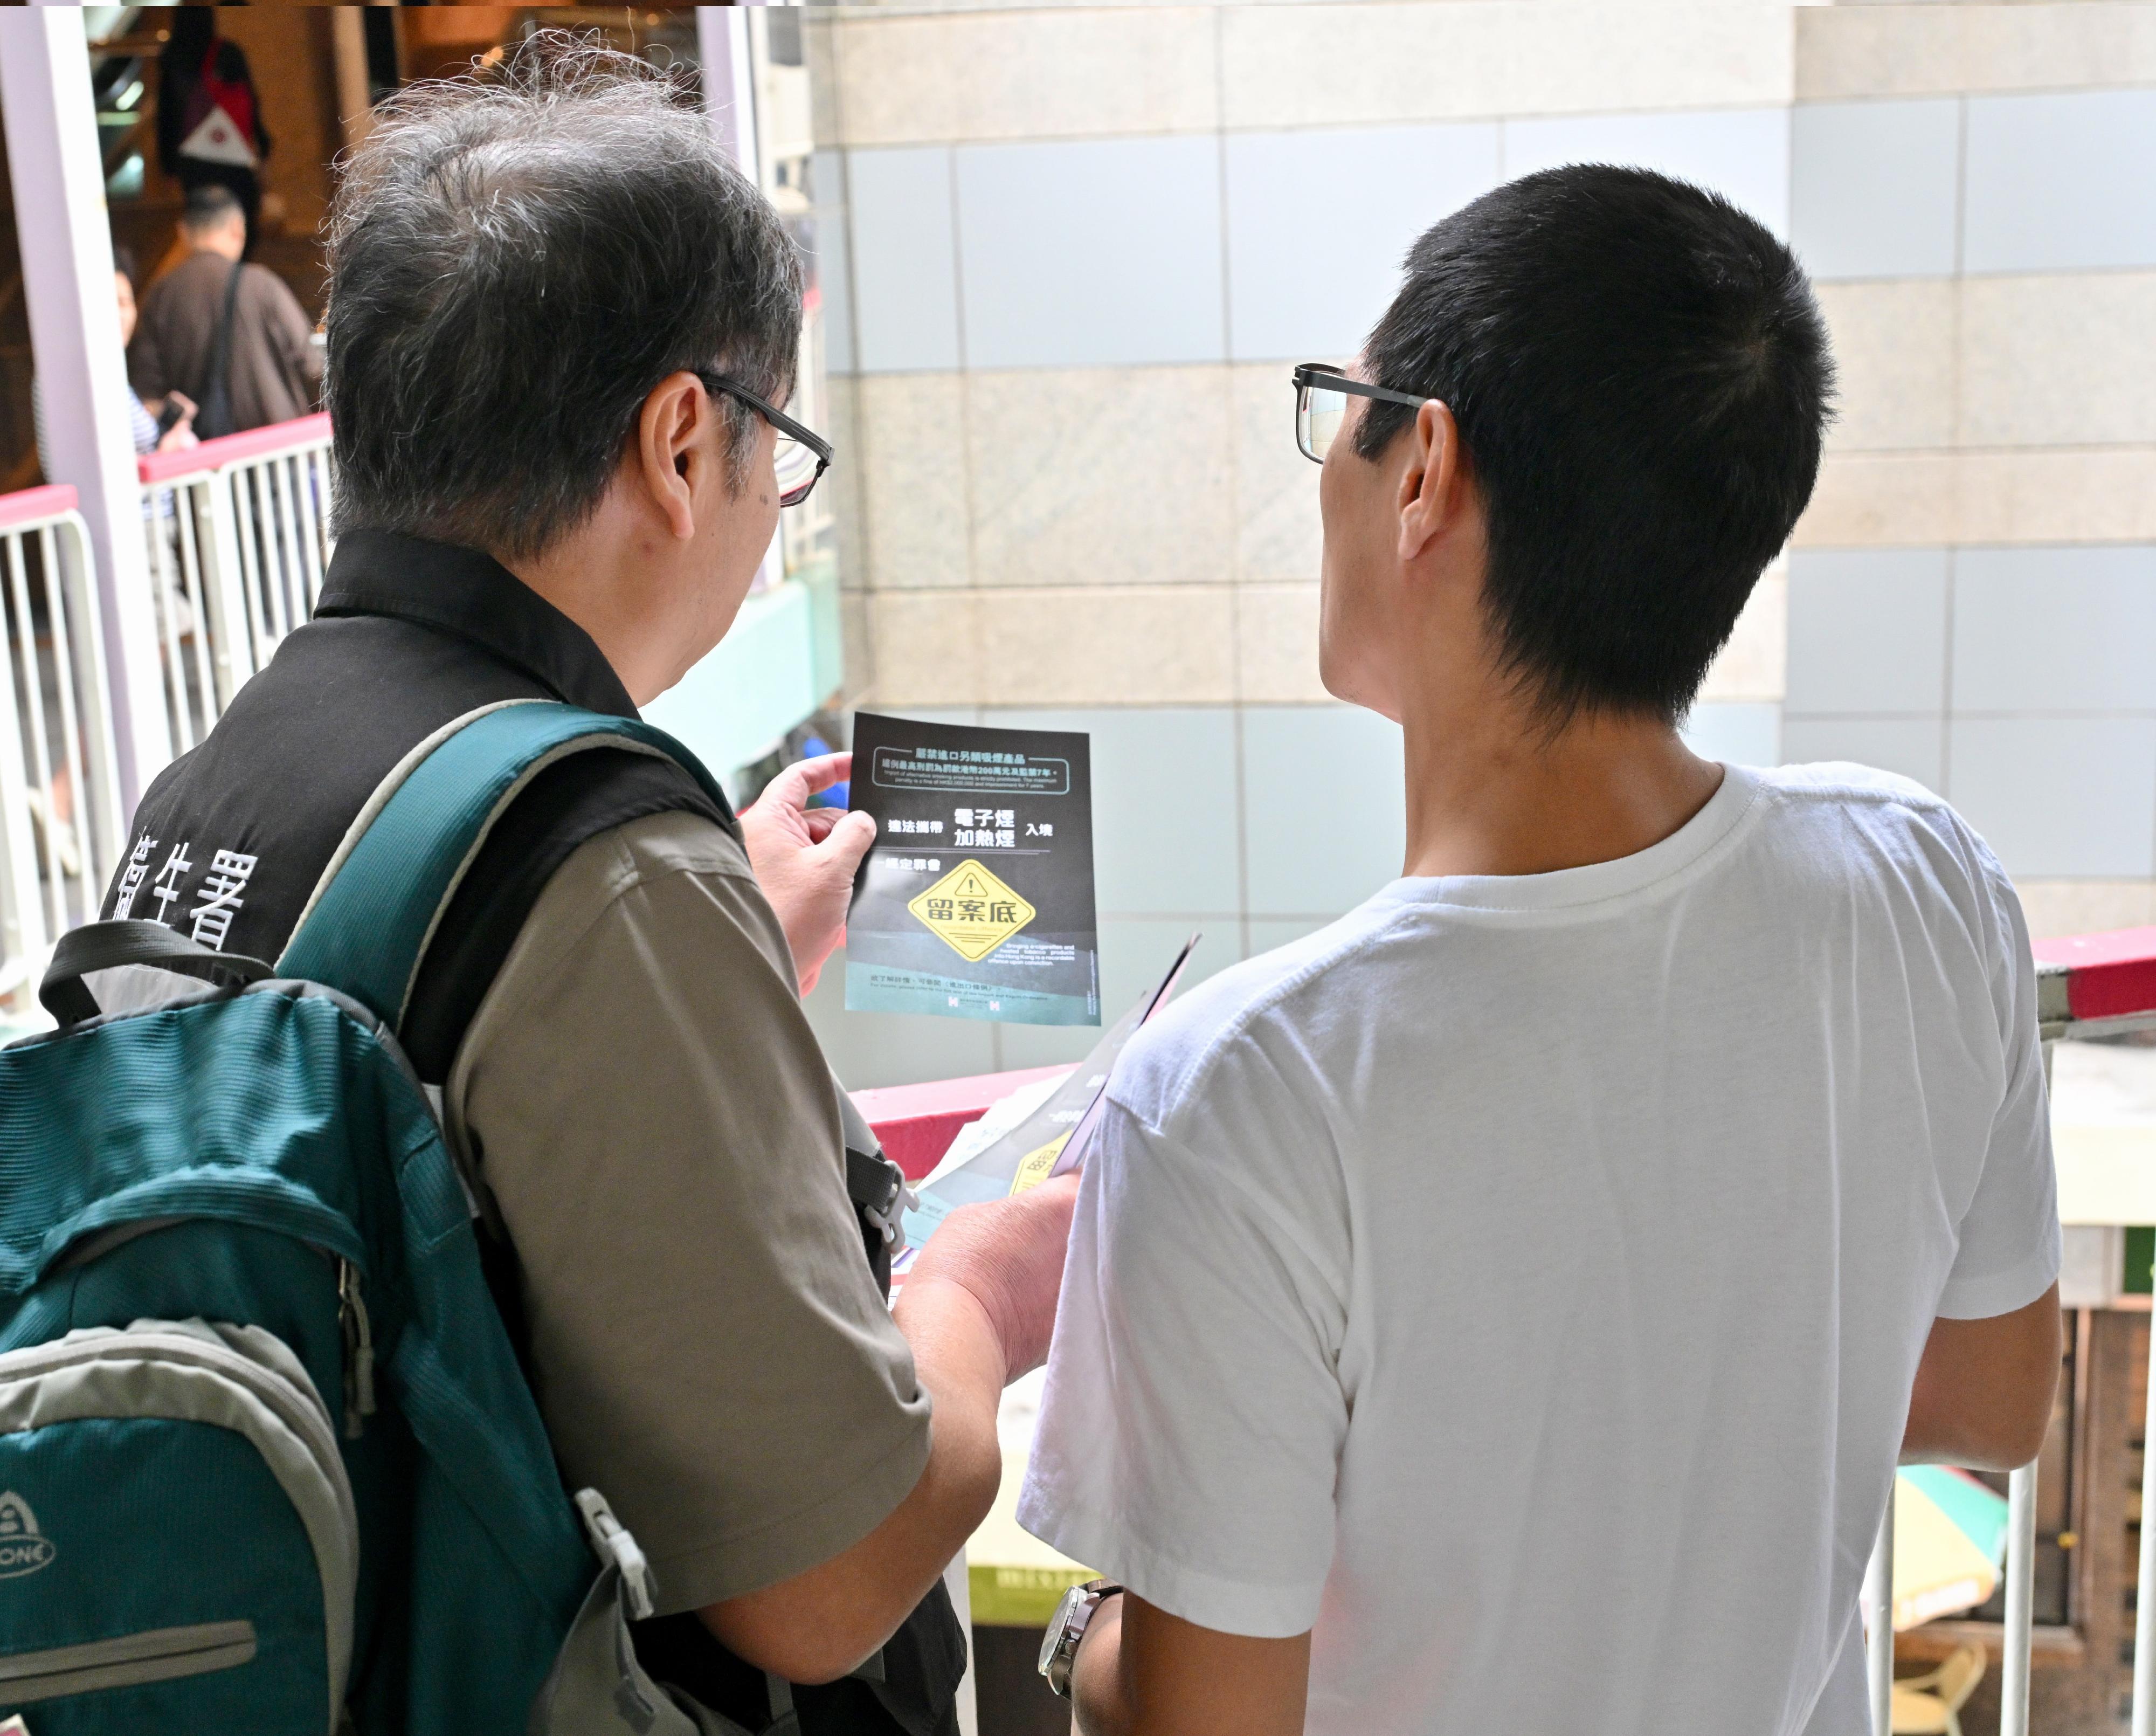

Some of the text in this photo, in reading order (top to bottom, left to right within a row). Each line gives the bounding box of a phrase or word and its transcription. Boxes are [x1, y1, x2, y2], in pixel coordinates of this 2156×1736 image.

[888, 819, 943, 833] 違法攜帶
[954, 808, 1015, 828] 電子煙
[954, 829, 1015, 848] 加熱煙
[1026, 823, 1053, 836] 入境
[927, 898, 1017, 923] 留案底
